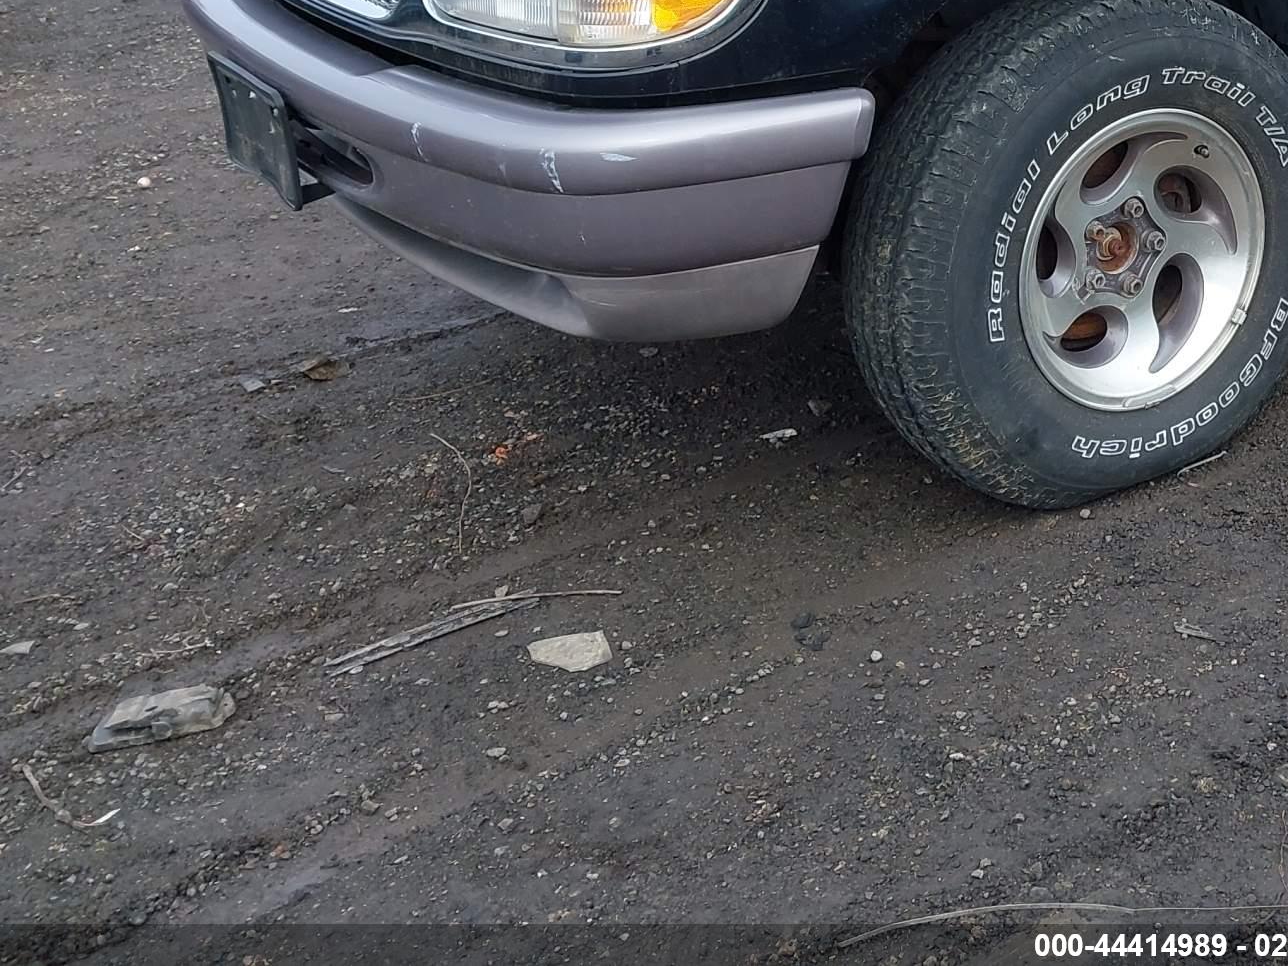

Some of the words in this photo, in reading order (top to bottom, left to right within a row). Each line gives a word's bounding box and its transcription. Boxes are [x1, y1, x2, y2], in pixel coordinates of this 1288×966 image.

[987, 159, 1041, 343] Radial
[1046, 74, 1151, 156] Long
[1162, 66, 1257, 108] Trail
